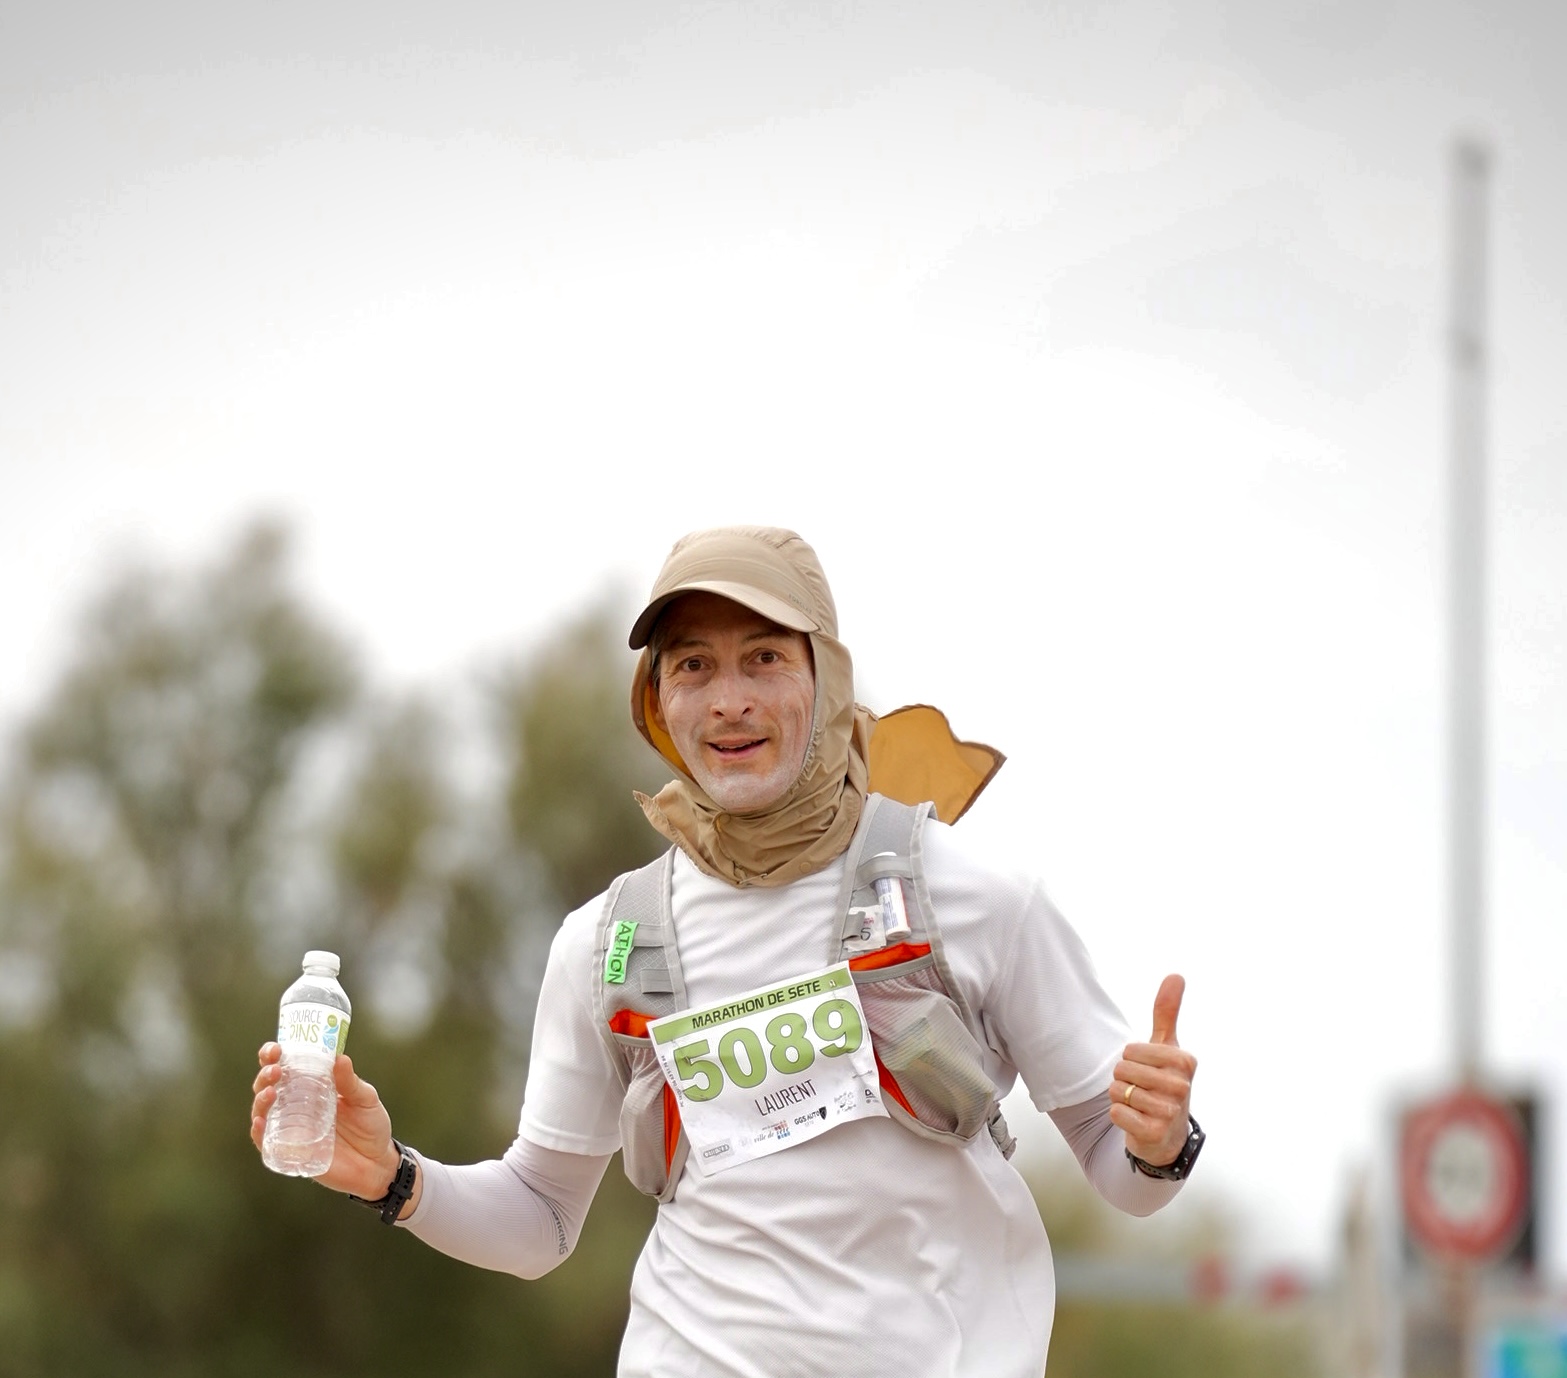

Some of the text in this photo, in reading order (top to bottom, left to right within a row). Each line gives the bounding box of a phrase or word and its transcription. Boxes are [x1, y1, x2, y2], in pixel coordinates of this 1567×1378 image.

[692, 980, 821, 1029] MARATHON DE SETE
[673, 998, 863, 1103] 5089
[754, 1079, 817, 1116] LAURENT
